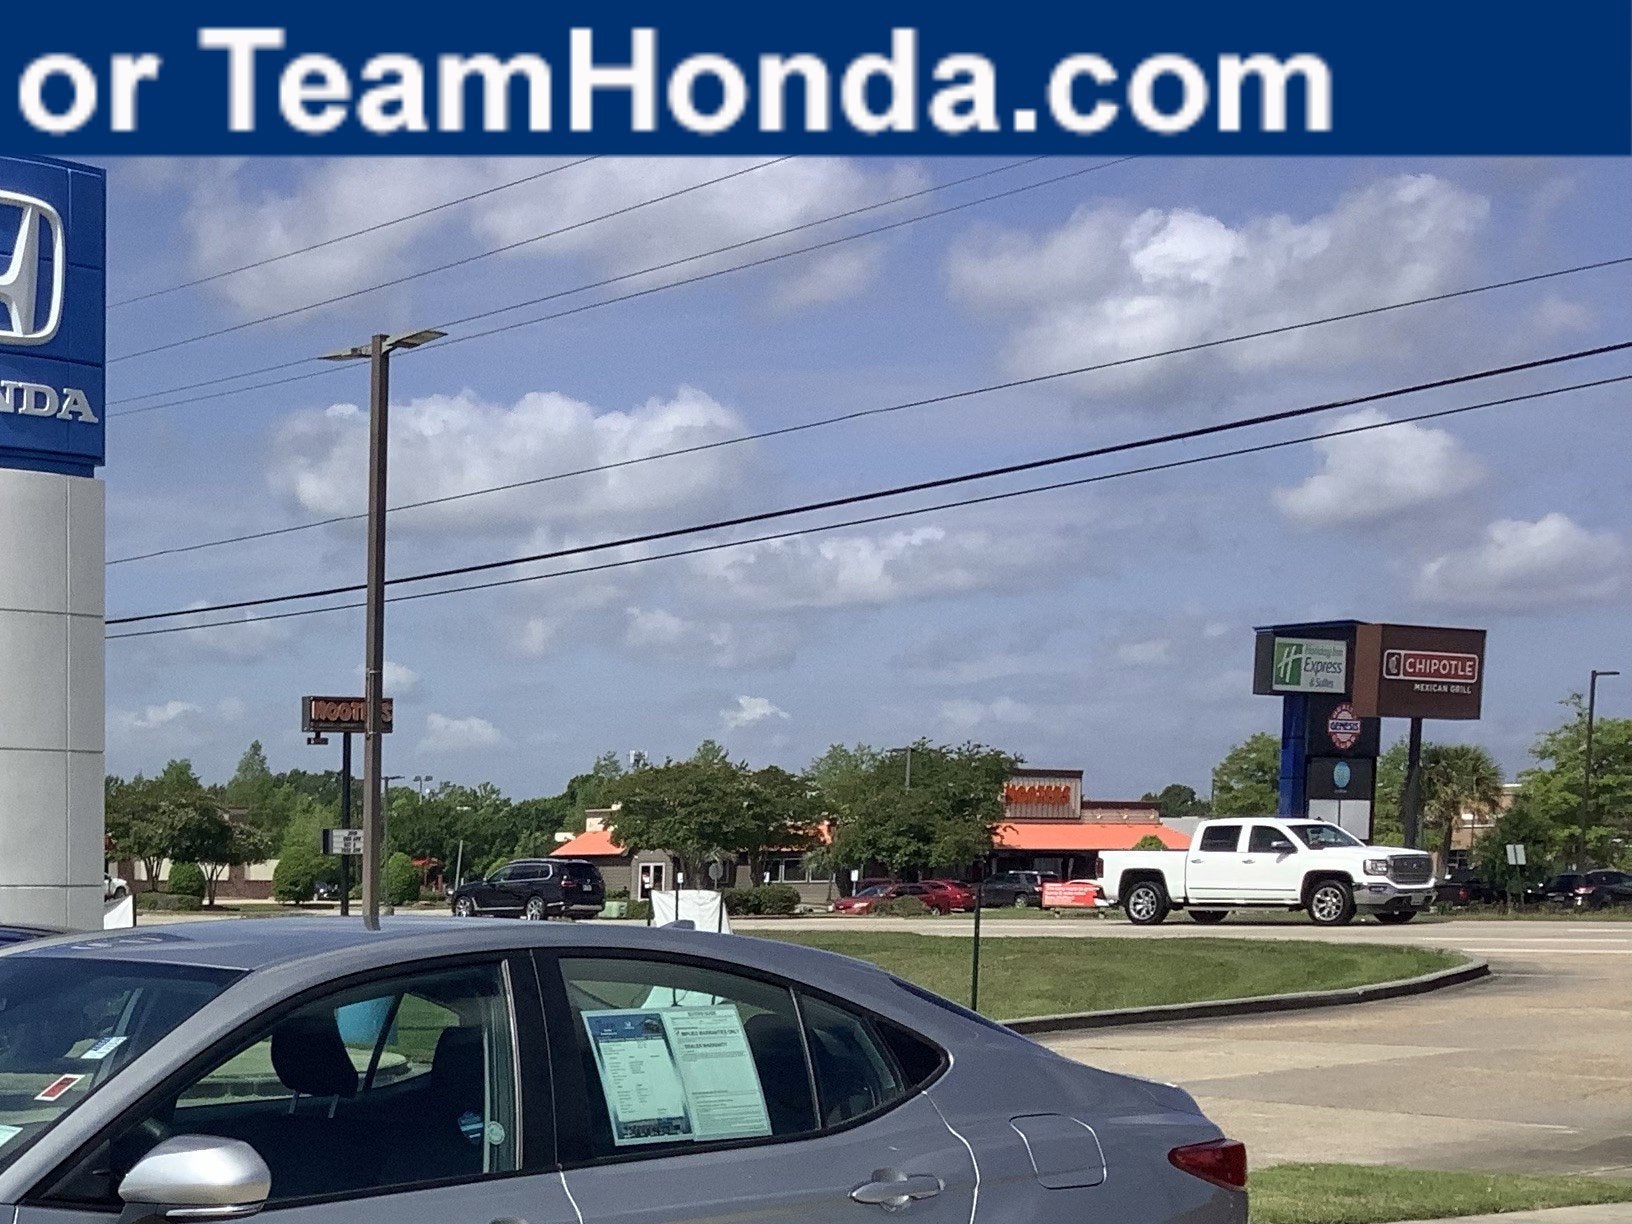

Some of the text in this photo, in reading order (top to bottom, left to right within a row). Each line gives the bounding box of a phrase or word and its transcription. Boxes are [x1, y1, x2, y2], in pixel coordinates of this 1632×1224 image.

[1304, 656, 1342, 675] Express
[1405, 658, 1474, 676] CHIPOTLE
[1413, 683, 1472, 694] MEXICAN GRILL
[311, 701, 392, 722] HOOTS
[1330, 721, 1359, 731] GENESIS
[1004, 784, 1071, 805] HOOTERS
